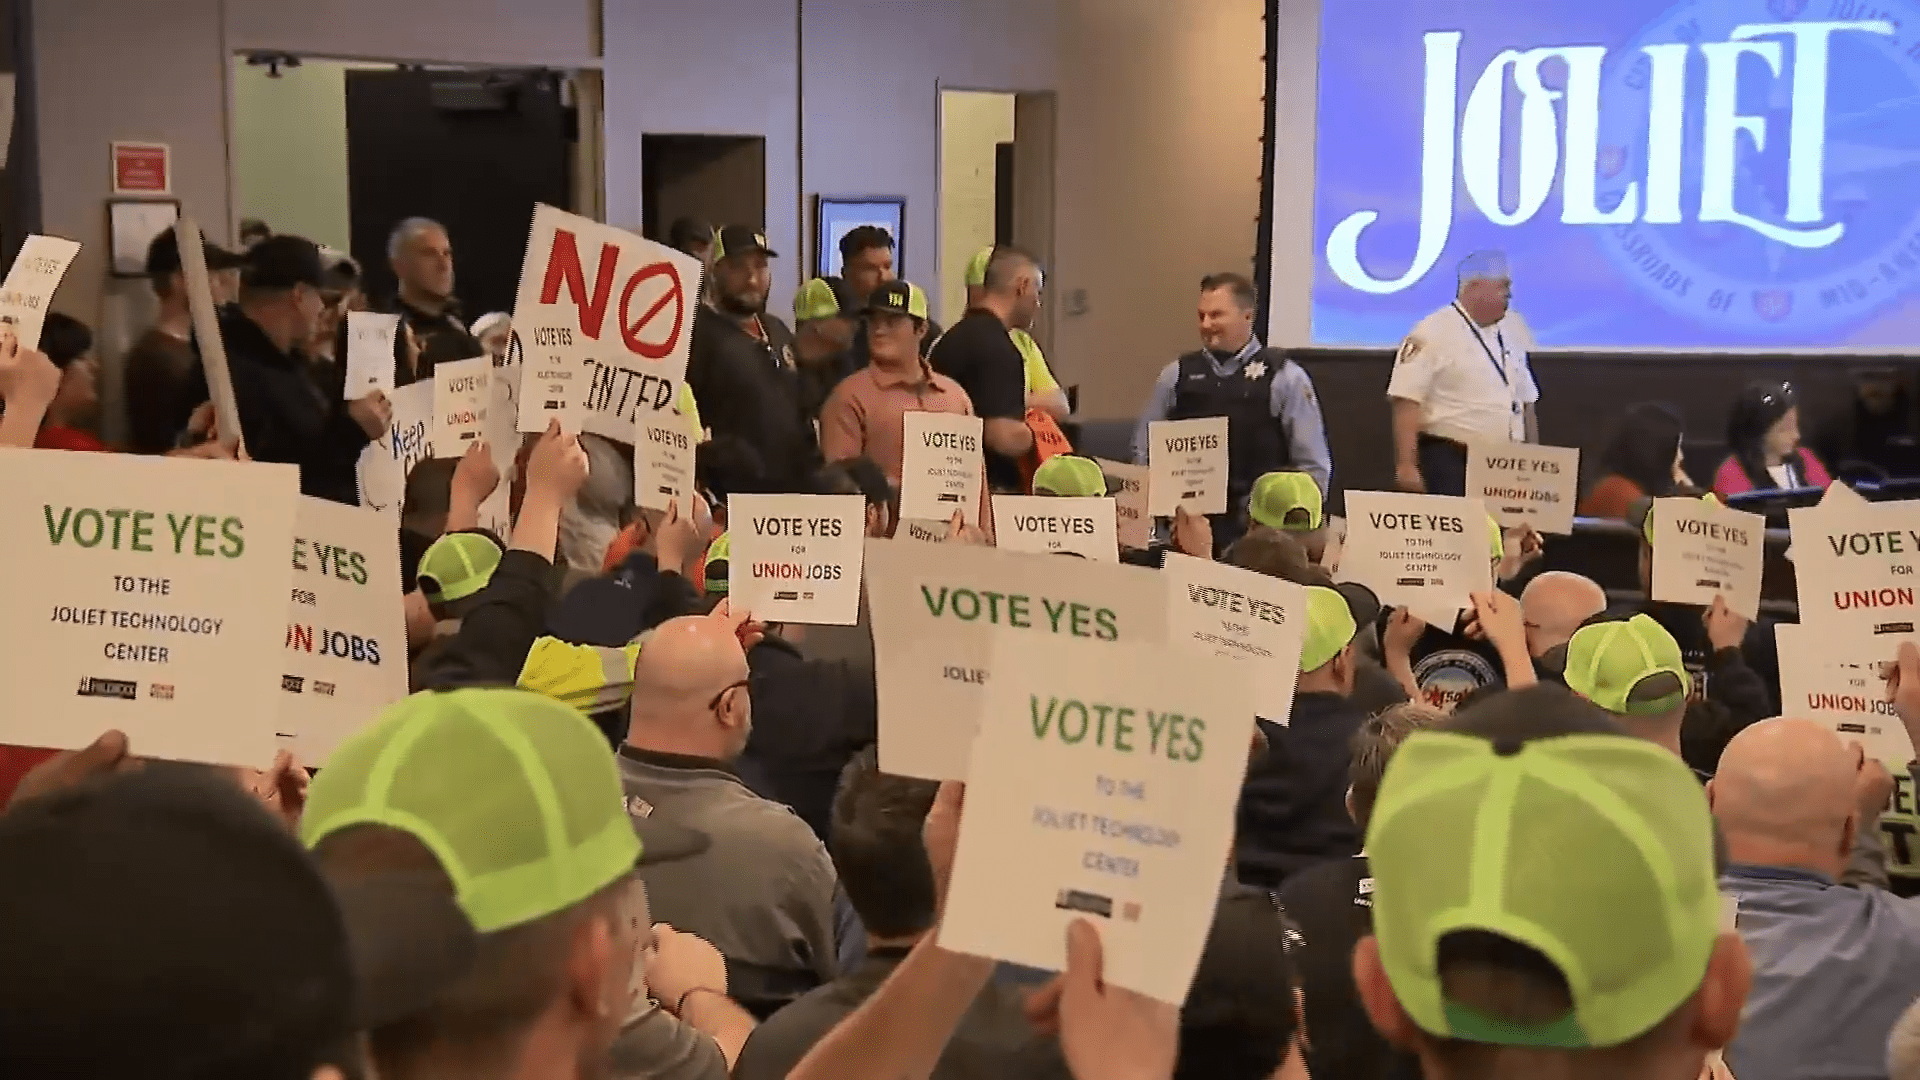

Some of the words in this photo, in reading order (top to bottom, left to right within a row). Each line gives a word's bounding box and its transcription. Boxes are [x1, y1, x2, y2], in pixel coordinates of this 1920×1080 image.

[1326, 21, 1895, 294] JOLIET
[533, 326, 556, 346] VOTE
[556, 327, 573, 346] YES
[391, 419, 425, 460] Keep
[646, 426, 672, 446] VOTE
[672, 431, 688, 450] YES
[922, 431, 957, 449] VOTE
[958, 434, 976, 452] YES
[1165, 437, 1198, 454] VOTE
[1198, 434, 1218, 450] YES
[1486, 456, 1526, 471] VOTE
[1531, 459, 1560, 475] YES
[1483, 486, 1528, 500] UNION
[44, 504, 155, 553] VOTE
[166, 512, 245, 559] YES
[753, 517, 802, 536] VOTE
[807, 517, 842, 537] YES
[1014, 515, 1057, 533] VOTE
[1060, 516, 1094, 534] YES
[1369, 512, 1423, 530] VOTE
[1423, 516, 1464, 534] YES
[1676, 518, 1720, 538] VOTE
[1721, 526, 1748, 547] YES
[1828, 530, 1905, 558] VOTE
[312, 541, 368, 585] YES
[752, 562, 803, 580] UNION
[806, 564, 842, 580] JOBS
[1890, 565, 1914, 576] FOR
[114, 575, 134, 593] TO
[137, 576, 171, 595] THE
[1188, 583, 1245, 614] VOTE
[1246, 596, 1286, 624] YES
[1834, 587, 1914, 610] UNION
[50, 605, 108, 627] JOLIET
[110, 609, 224, 636] TECHNOLOGY
[920, 584, 1032, 629] VOTE
[1038, 598, 1119, 642] YES
[104, 642, 170, 664] CENTER
[318, 628, 381, 666] JOBS
[942, 665, 990, 685] JOLIE
[1808, 692, 1866, 713] UNION
[1869, 699, 1897, 716] JOB
[1030, 695, 1136, 753] VOTE
[1146, 708, 1207, 762] YES
